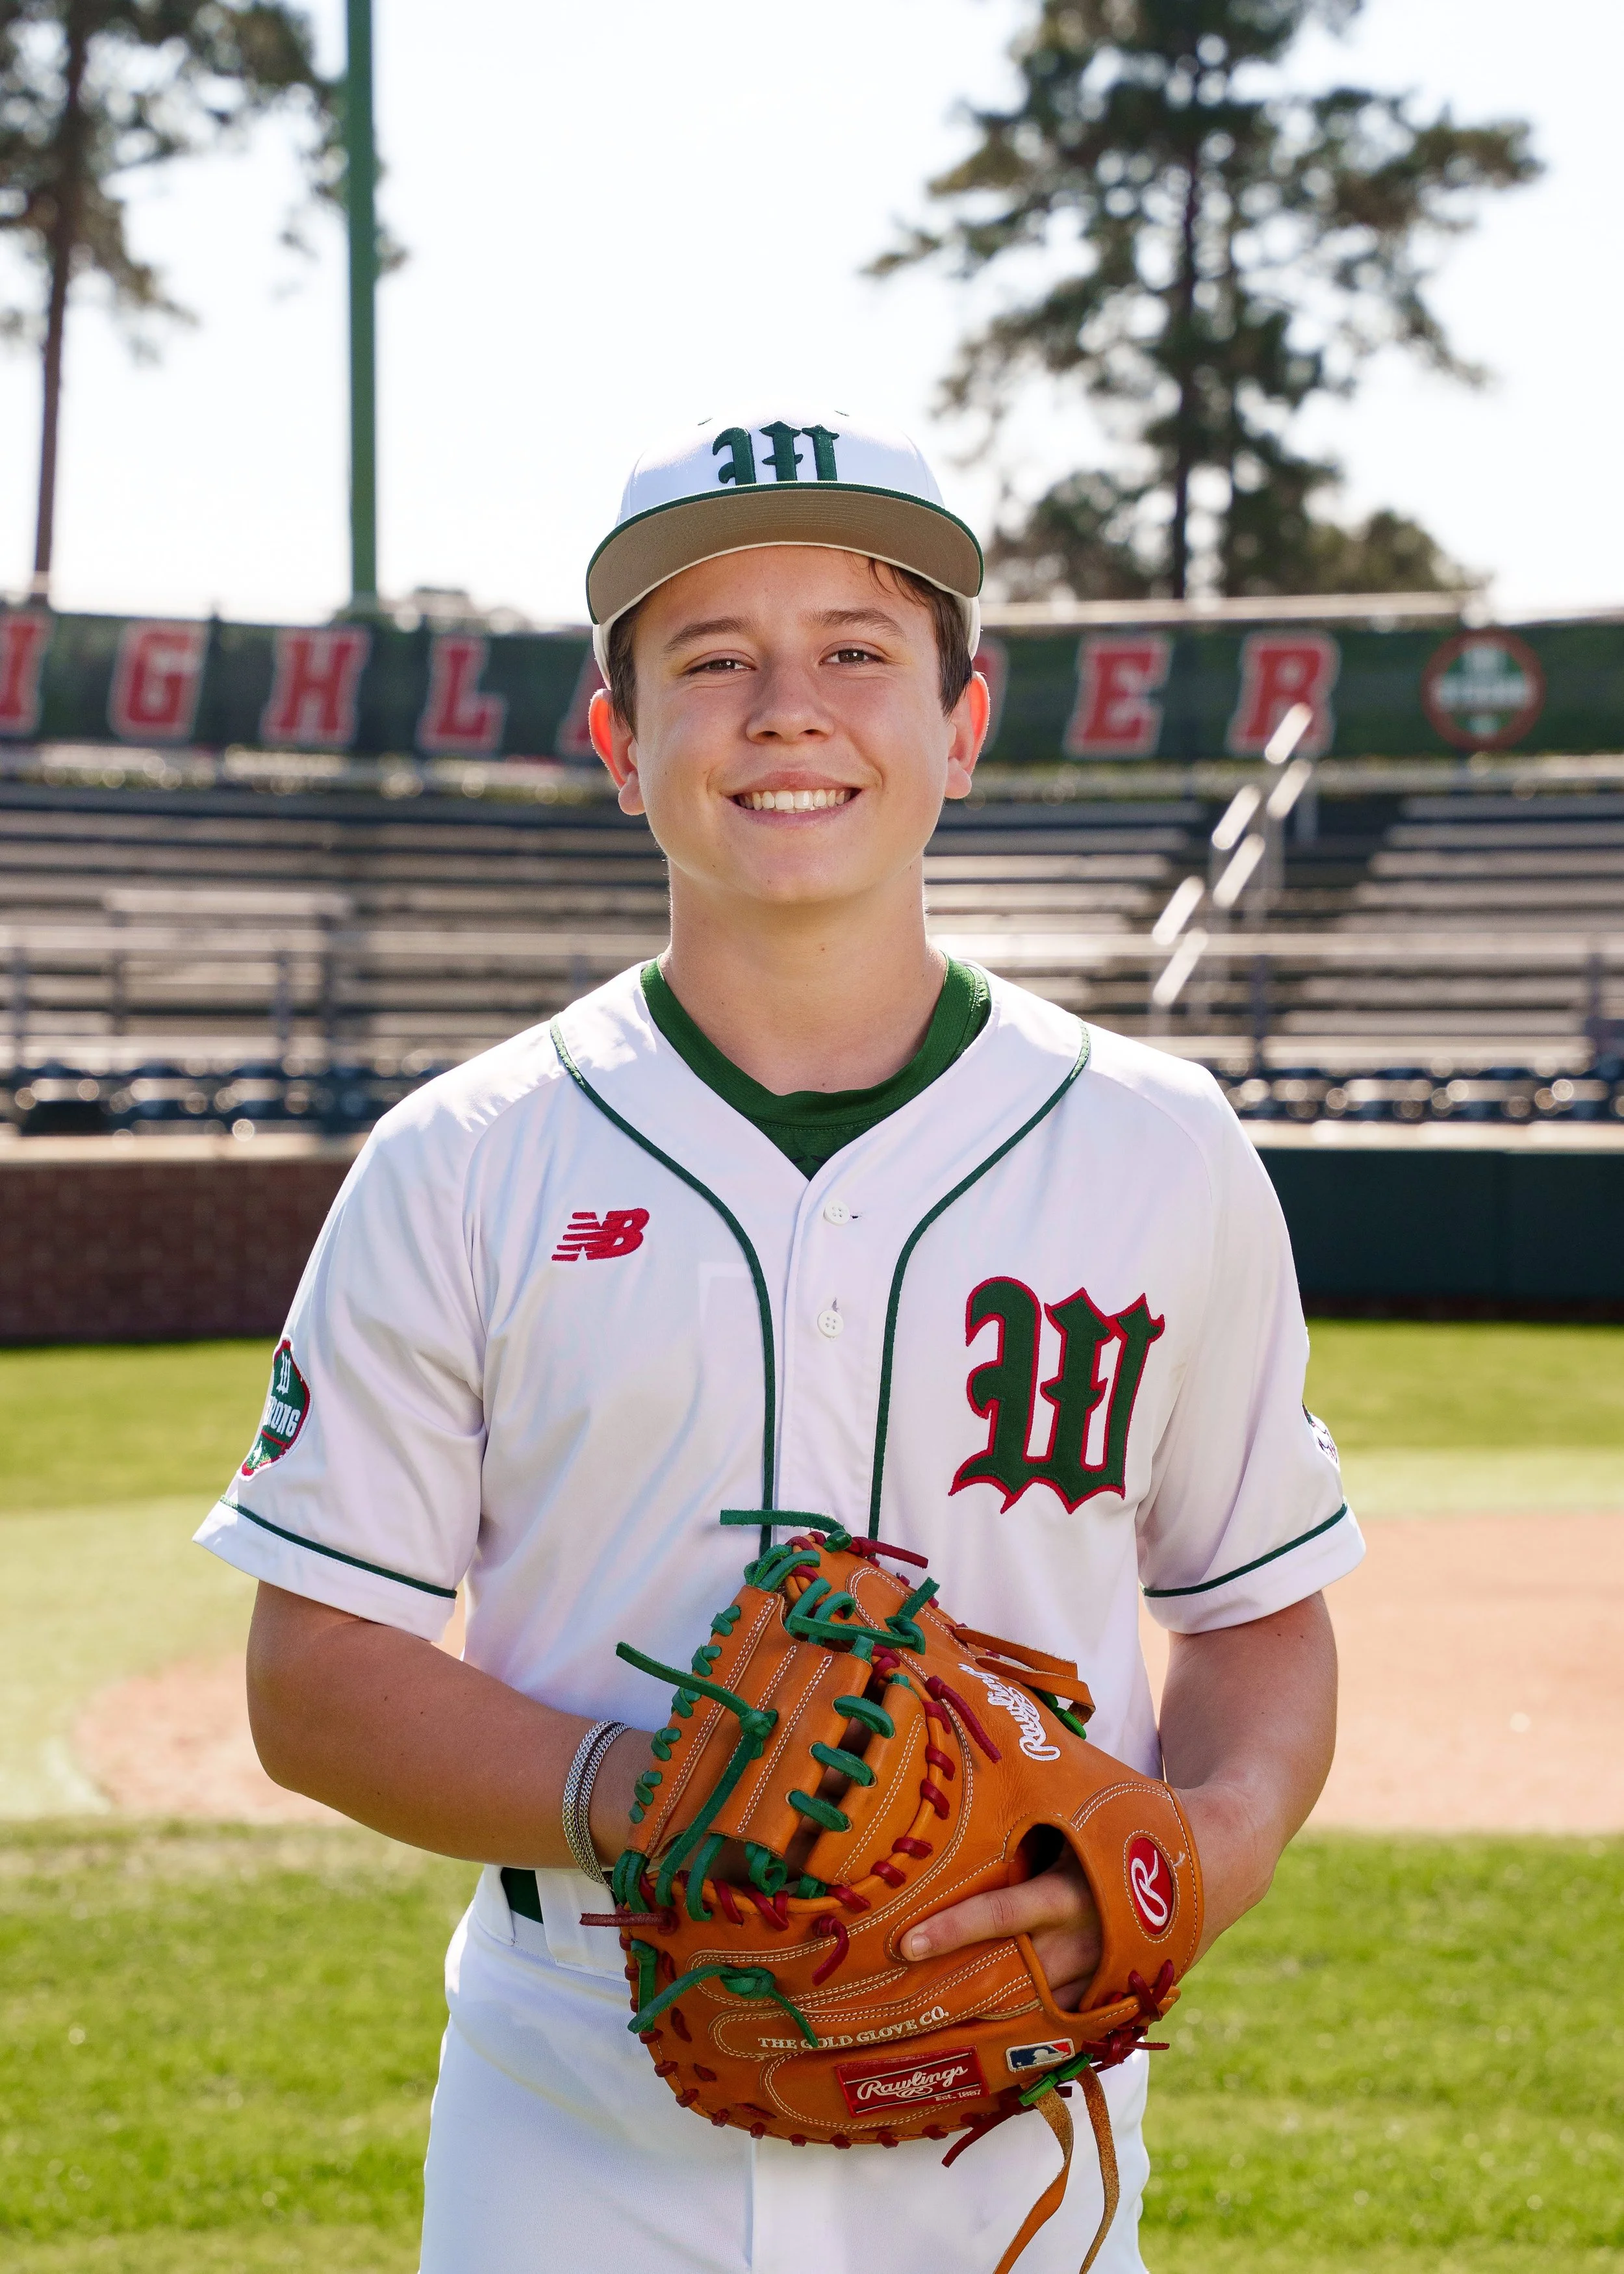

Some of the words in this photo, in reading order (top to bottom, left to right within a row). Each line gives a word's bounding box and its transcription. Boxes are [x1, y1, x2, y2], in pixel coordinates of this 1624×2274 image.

[552, 1208, 650, 1262] NB
[958, 1663, 1061, 1761] Rawlings
[757, 2038, 798, 2050] THE
[800, 2036, 854, 2049] GOLD
[857, 2019, 918, 2043] GLOVE
[919, 2006, 950, 2026] CO.
[857, 2065, 969, 2100] Rawlings
[957, 2089, 982, 2098] 1887
